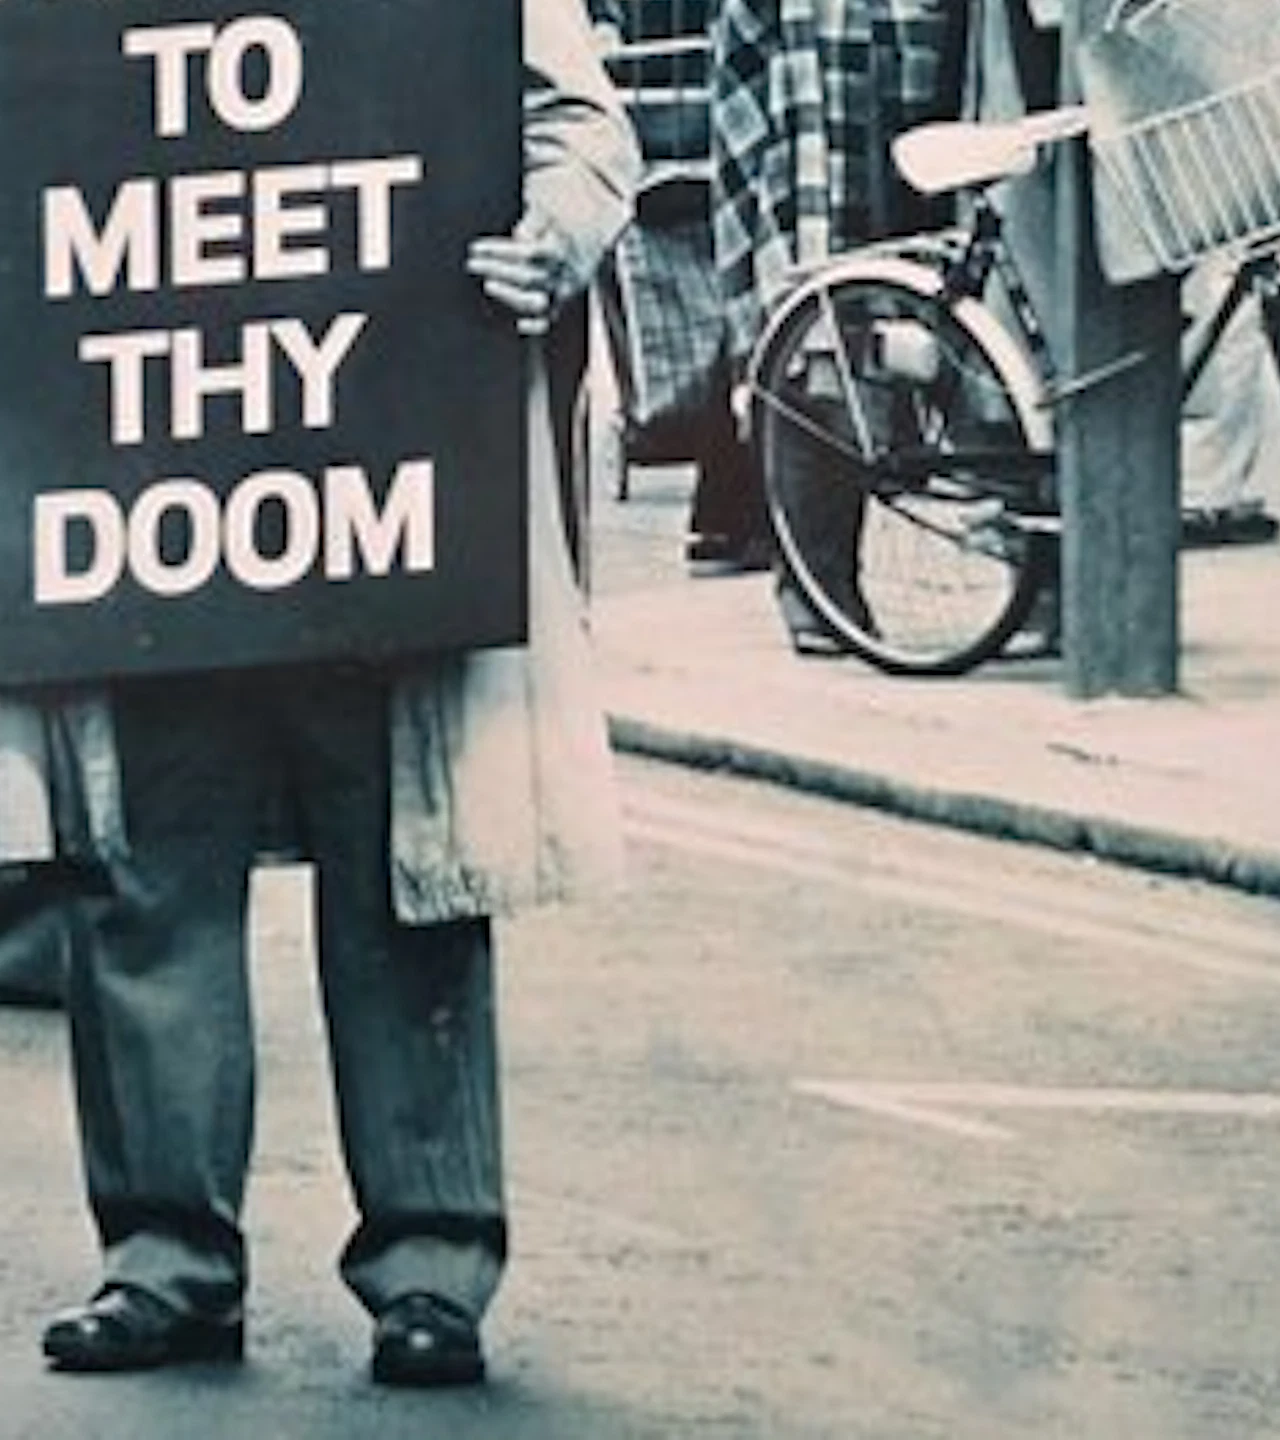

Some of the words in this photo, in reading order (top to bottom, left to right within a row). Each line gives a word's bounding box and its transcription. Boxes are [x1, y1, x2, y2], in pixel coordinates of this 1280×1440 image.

[124, 17, 302, 136] TO
[44, 157, 421, 297] MEET
[79, 313, 366, 444] THY
[34, 461, 434, 604] DOOM
